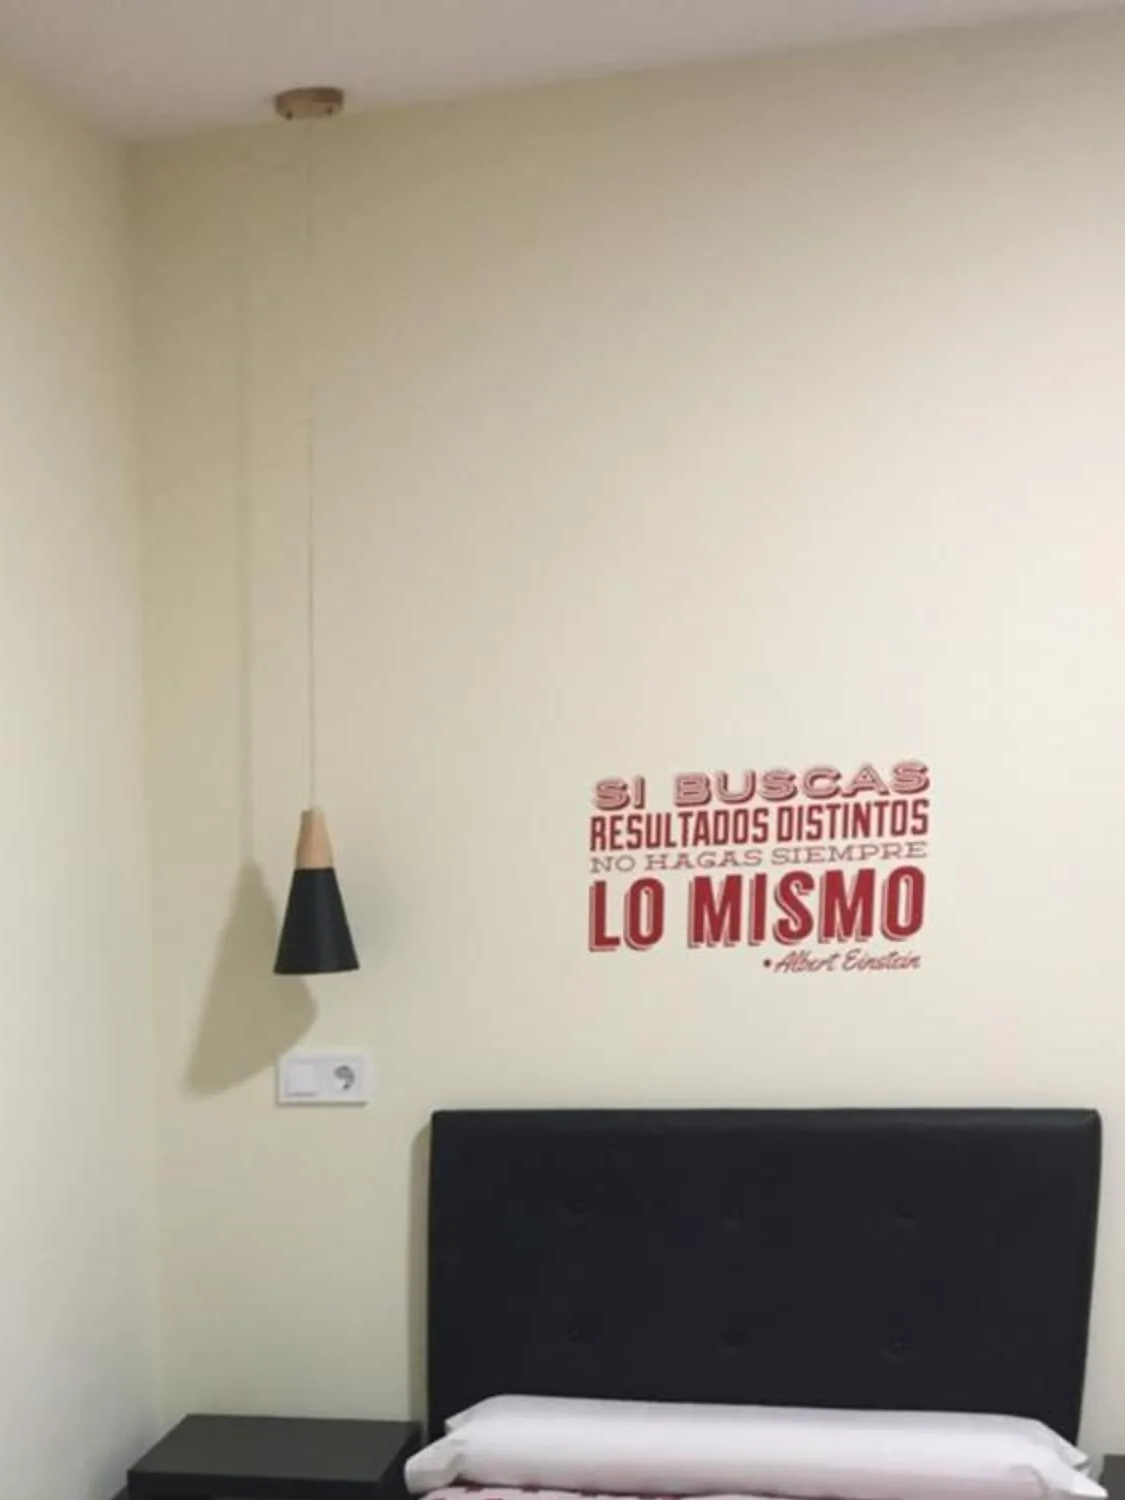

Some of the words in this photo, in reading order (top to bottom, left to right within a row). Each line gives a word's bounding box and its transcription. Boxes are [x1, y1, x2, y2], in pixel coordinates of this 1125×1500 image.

[593, 776, 646, 811] SI
[673, 761, 931, 807] BUSCAS
[589, 807, 770, 851] RESULTADOS
[776, 799, 930, 843] DISTINTOS
[588, 855, 636, 875] NO
[644, 849, 763, 871] HAGAS
[770, 841, 929, 866] SIEMPRE
[589, 877, 665, 952] LO
[687, 865, 925, 949] MISMO
[775, 951, 837, 973] Albert
[841, 949, 922, 972] Einstein
